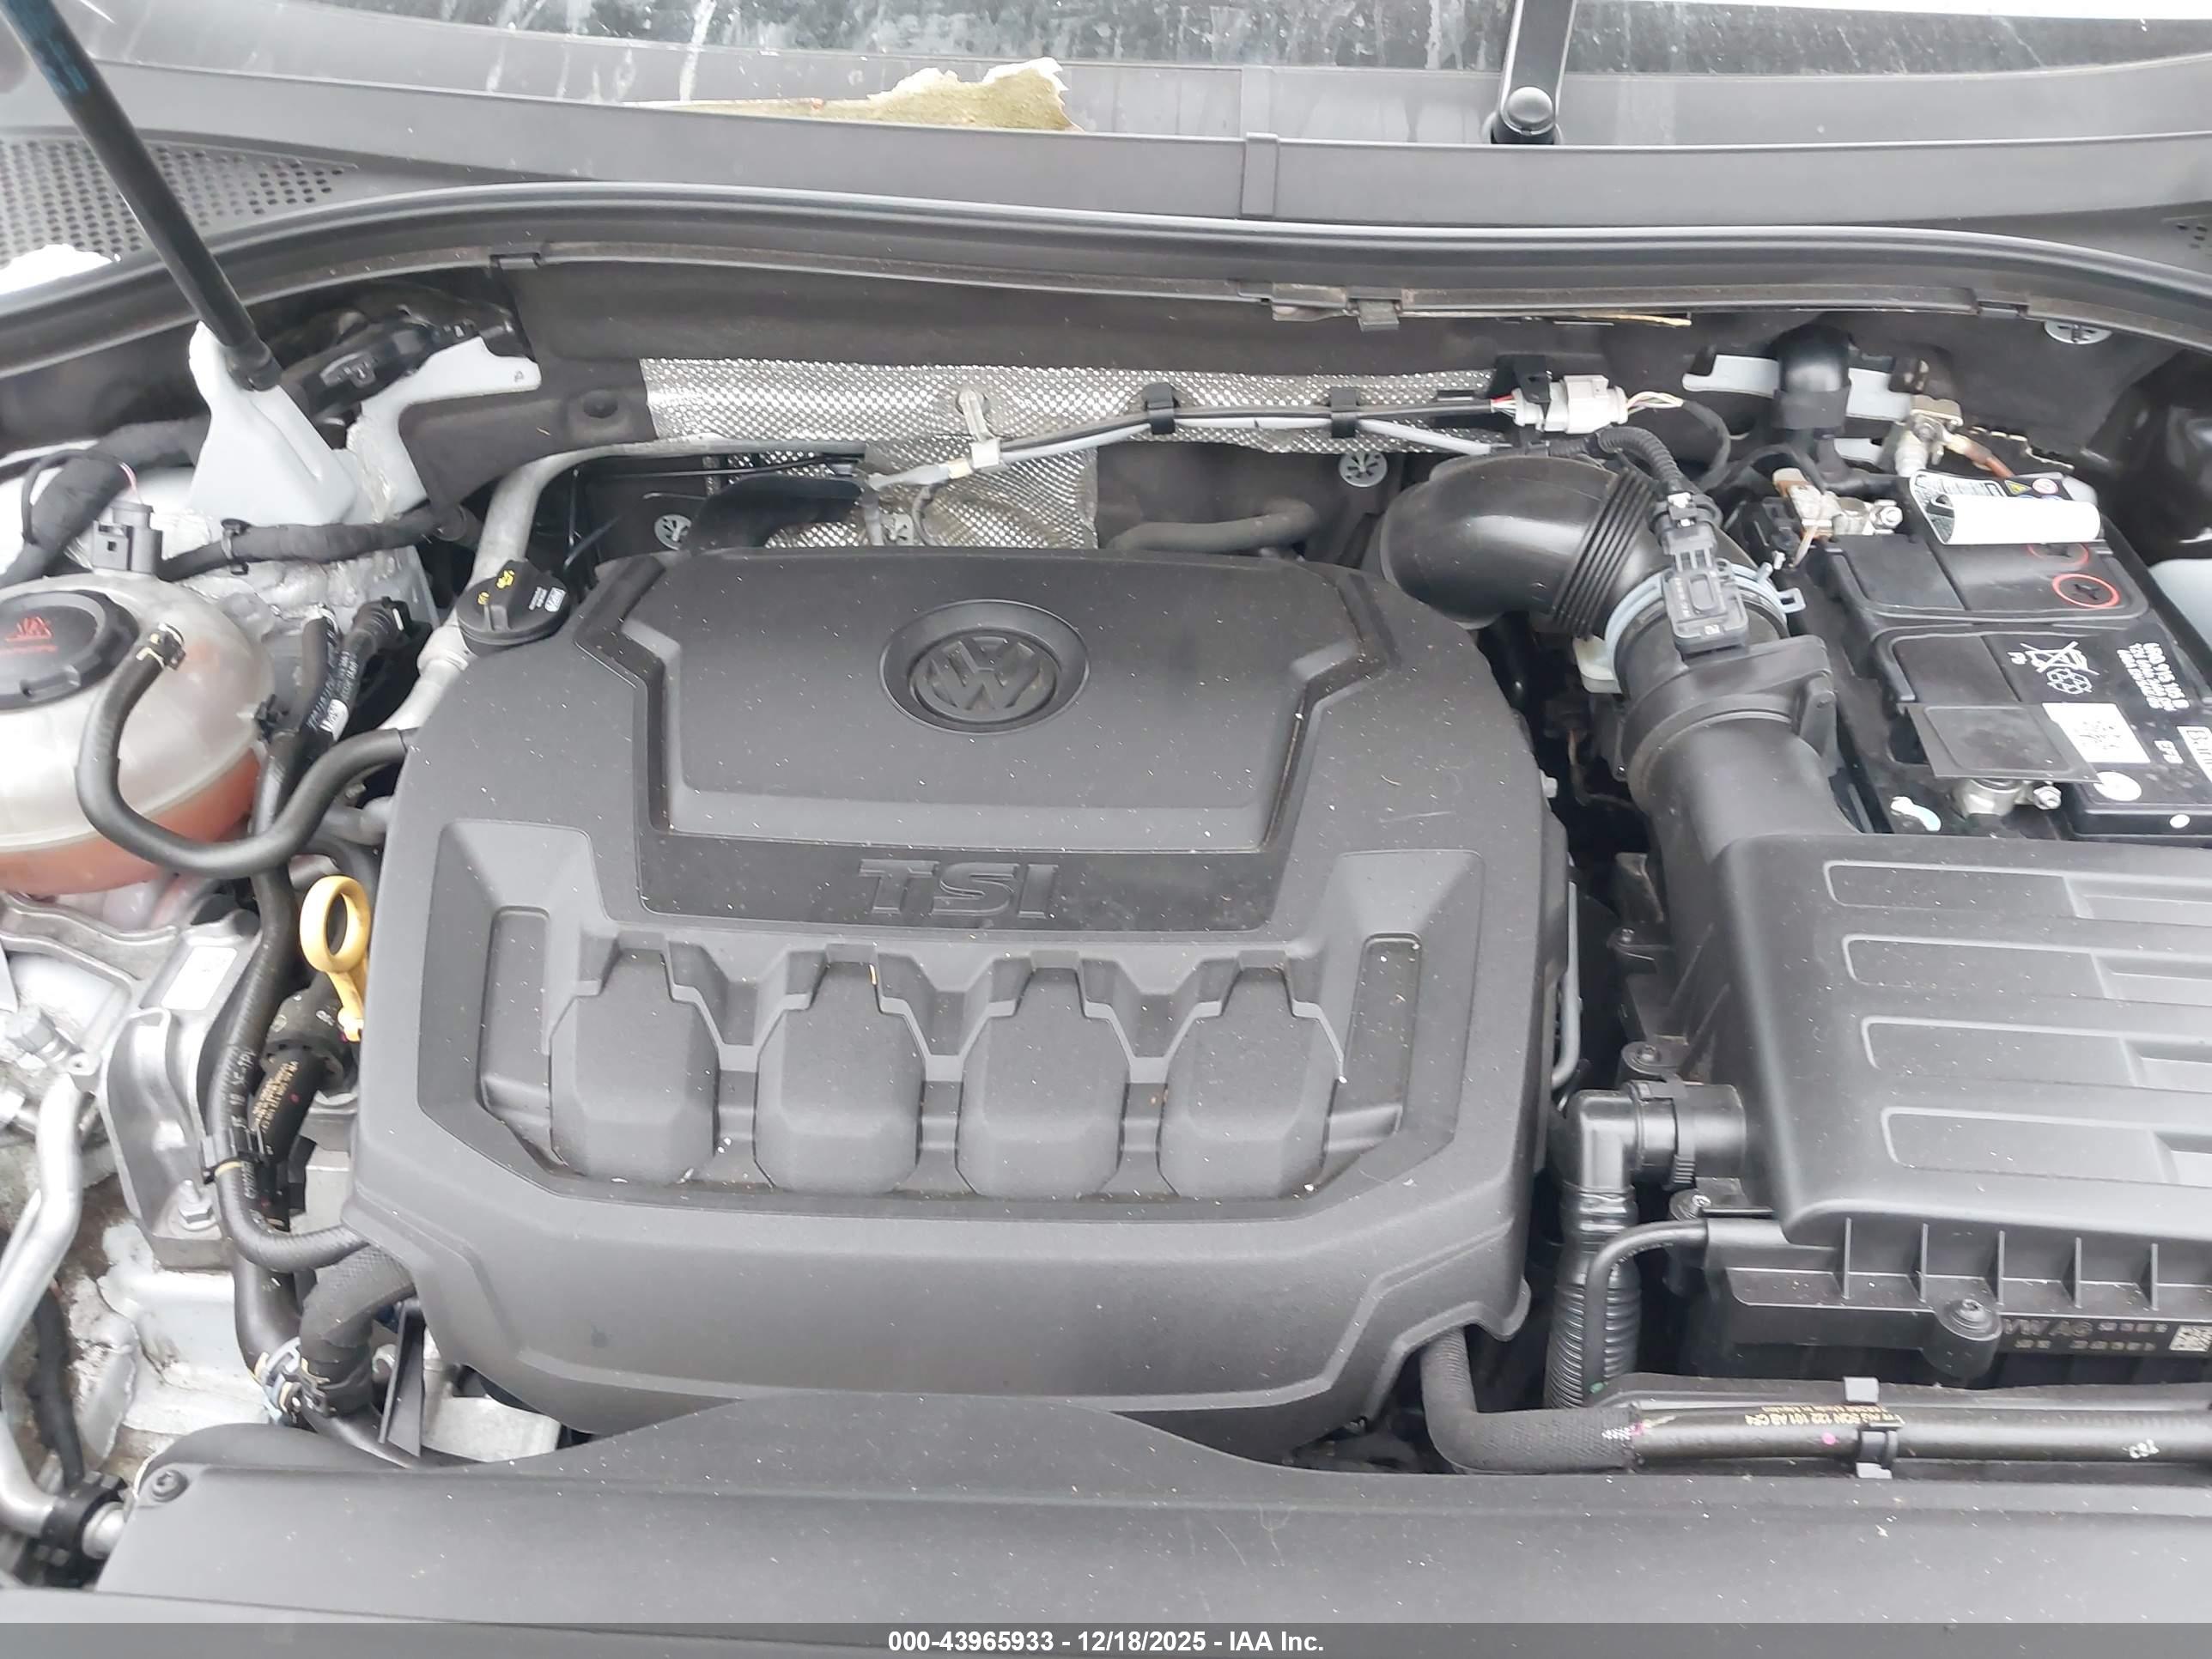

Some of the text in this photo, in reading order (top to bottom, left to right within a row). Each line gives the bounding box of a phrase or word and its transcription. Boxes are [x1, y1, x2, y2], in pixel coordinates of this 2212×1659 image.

[860, 859, 1059, 919] TSI
[2002, 1318, 2051, 1336] VW
[2049, 1320, 2094, 1338] AG
